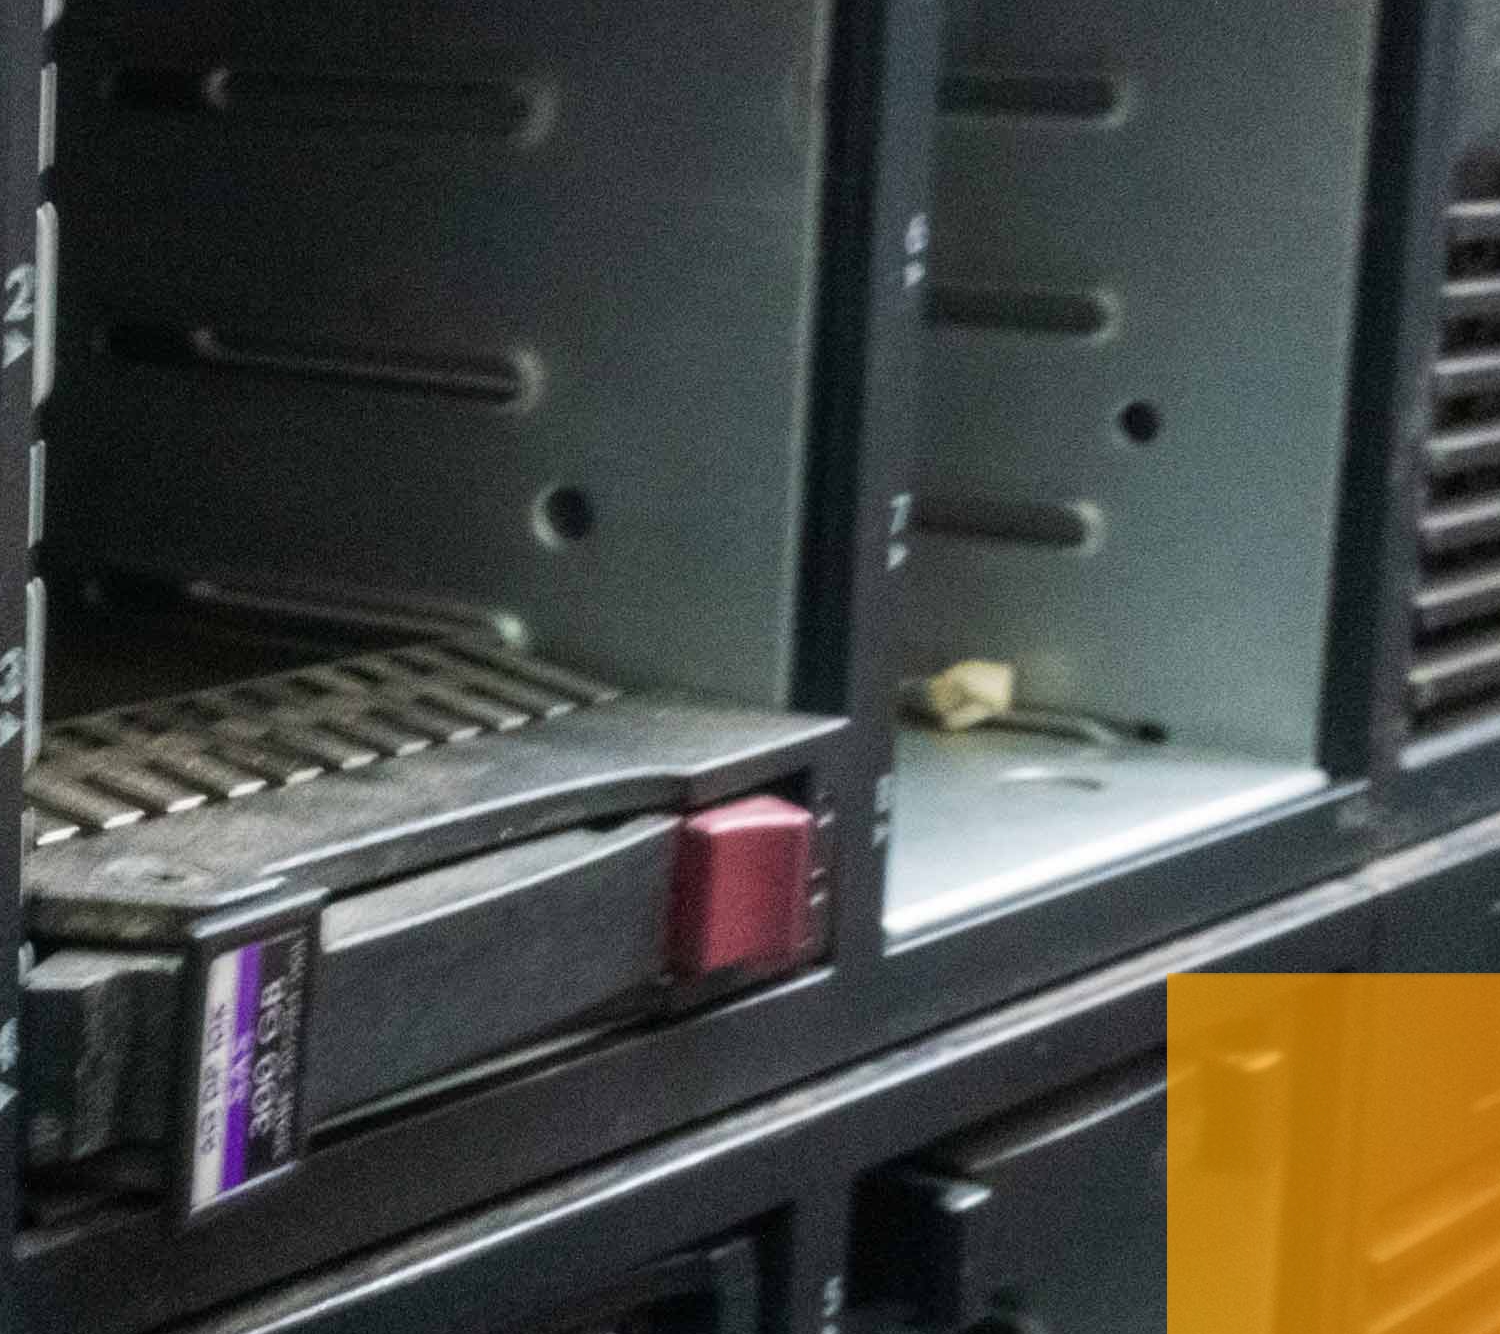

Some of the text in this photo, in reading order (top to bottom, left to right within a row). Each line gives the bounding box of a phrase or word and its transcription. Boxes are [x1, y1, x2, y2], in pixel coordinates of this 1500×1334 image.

[5, 263, 35, 323] 2
[228, 1027, 255, 1106] SAS
[247, 975, 287, 1141] 300 GB
